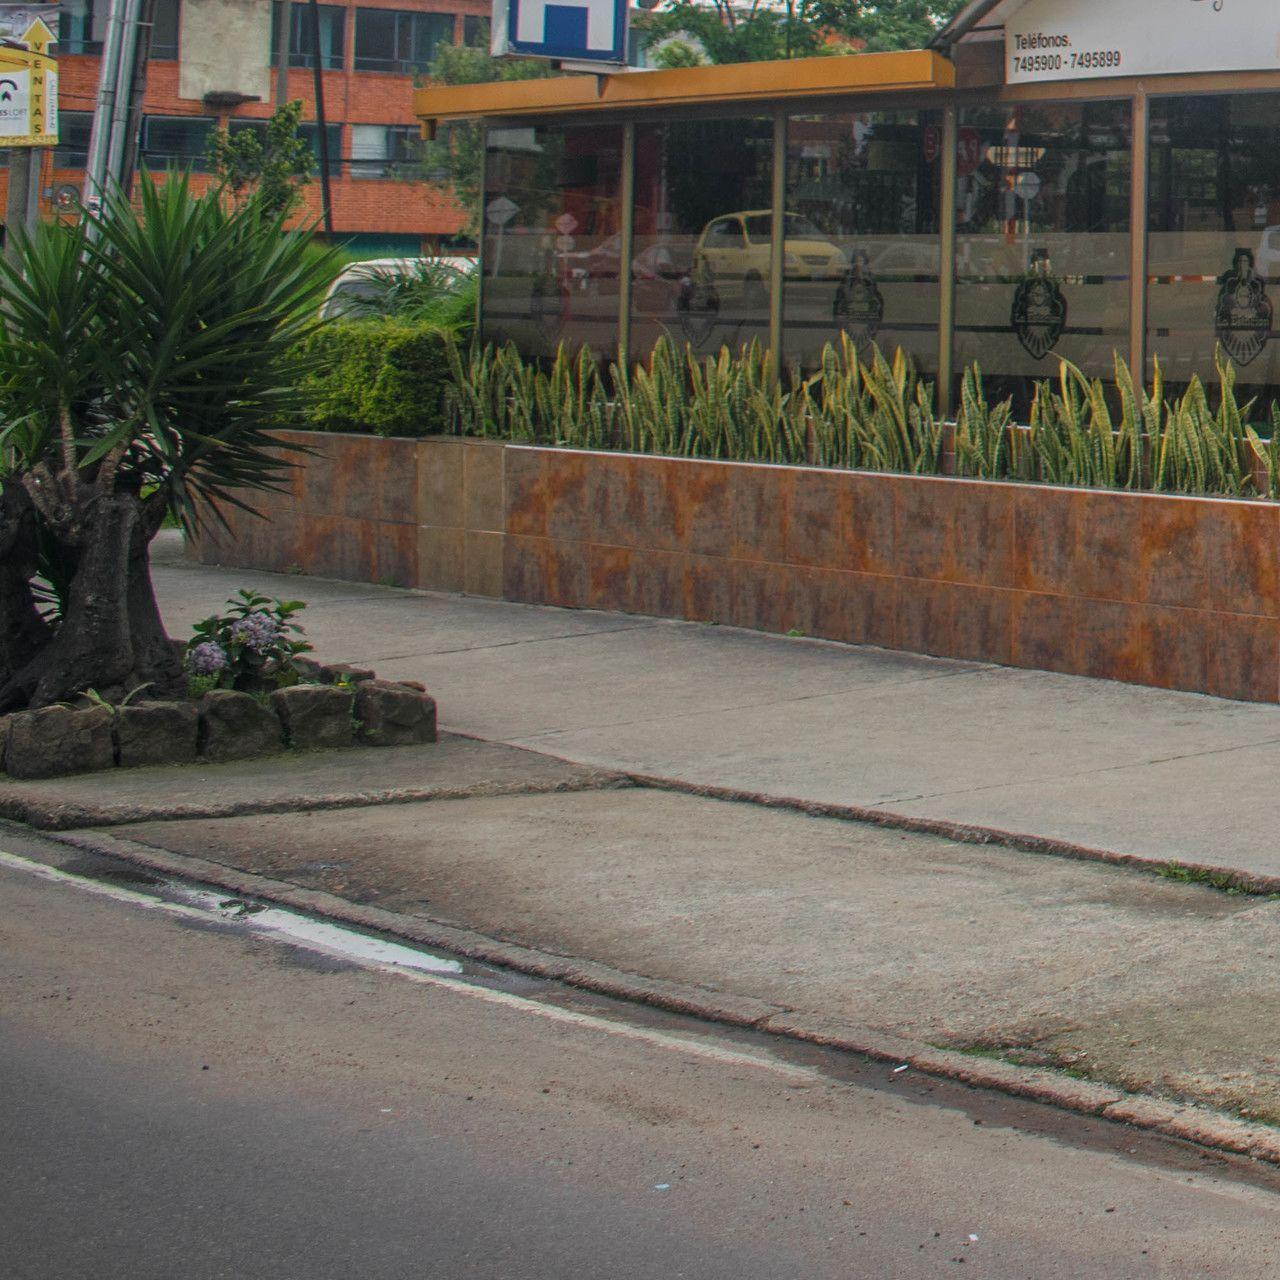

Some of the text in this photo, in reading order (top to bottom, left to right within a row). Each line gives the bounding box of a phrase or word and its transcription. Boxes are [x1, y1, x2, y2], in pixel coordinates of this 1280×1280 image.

[1014, 32, 1072, 50] Teléfonos.
[1014, 54, 1061, 73] 7495900
[1070, 51, 1121, 69] 7495899
[33, 41, 43, 133] VENTAS
